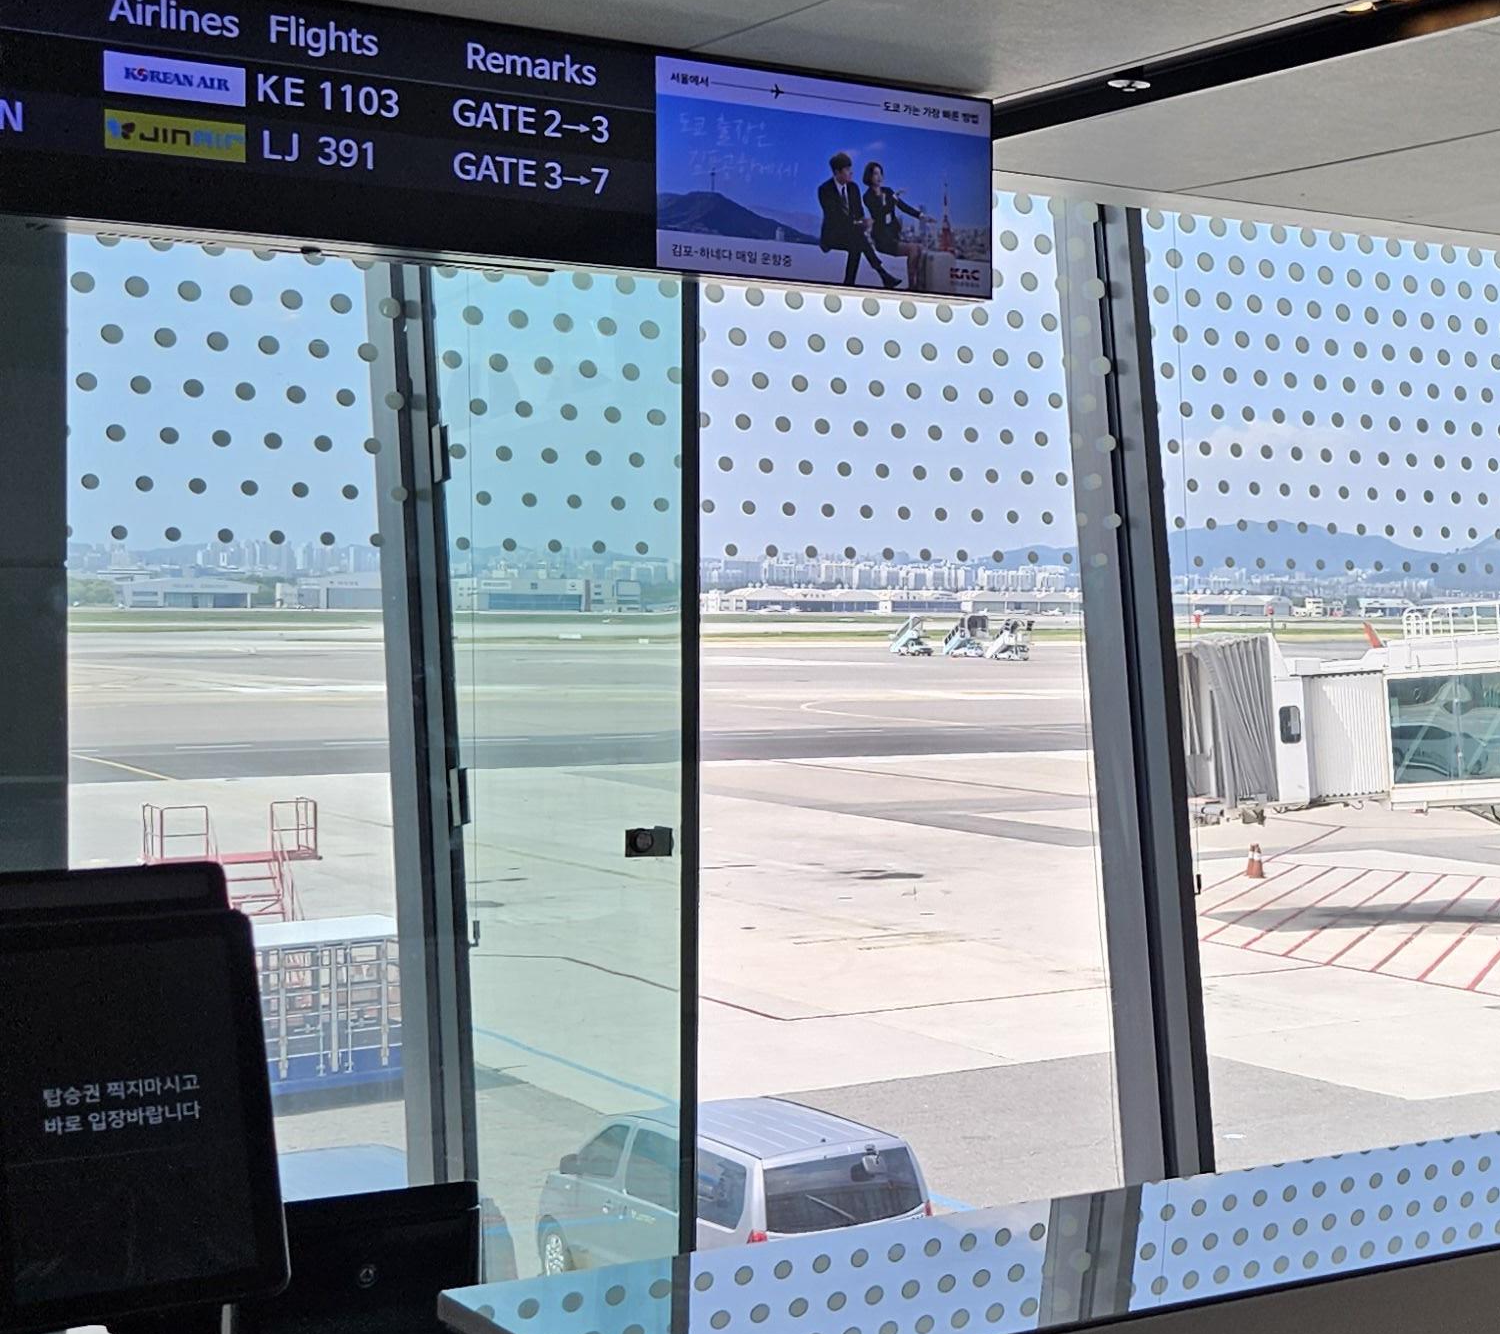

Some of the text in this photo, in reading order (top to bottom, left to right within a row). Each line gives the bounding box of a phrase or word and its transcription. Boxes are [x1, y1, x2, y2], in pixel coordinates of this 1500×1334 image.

[269, 14, 379, 57] Flights
[466, 42, 597, 86] Remarks
[670, 72, 709, 87] 서울에서
[124, 67, 194, 87] KOREAN
[196, 75, 230, 91] AIR
[257, 73, 305, 107] KE
[320, 81, 400, 118] 1103
[452, 98, 537, 135] GATE
[263, 129, 299, 162] LJ
[318, 136, 374, 169] 391
[453, 152, 537, 187] GATE
[950, 267, 980, 281] KAC
[43, 1074, 200, 1108] 탑승권 찍지마시고
[44, 1101, 201, 1135] 바로 입장바랍니다
